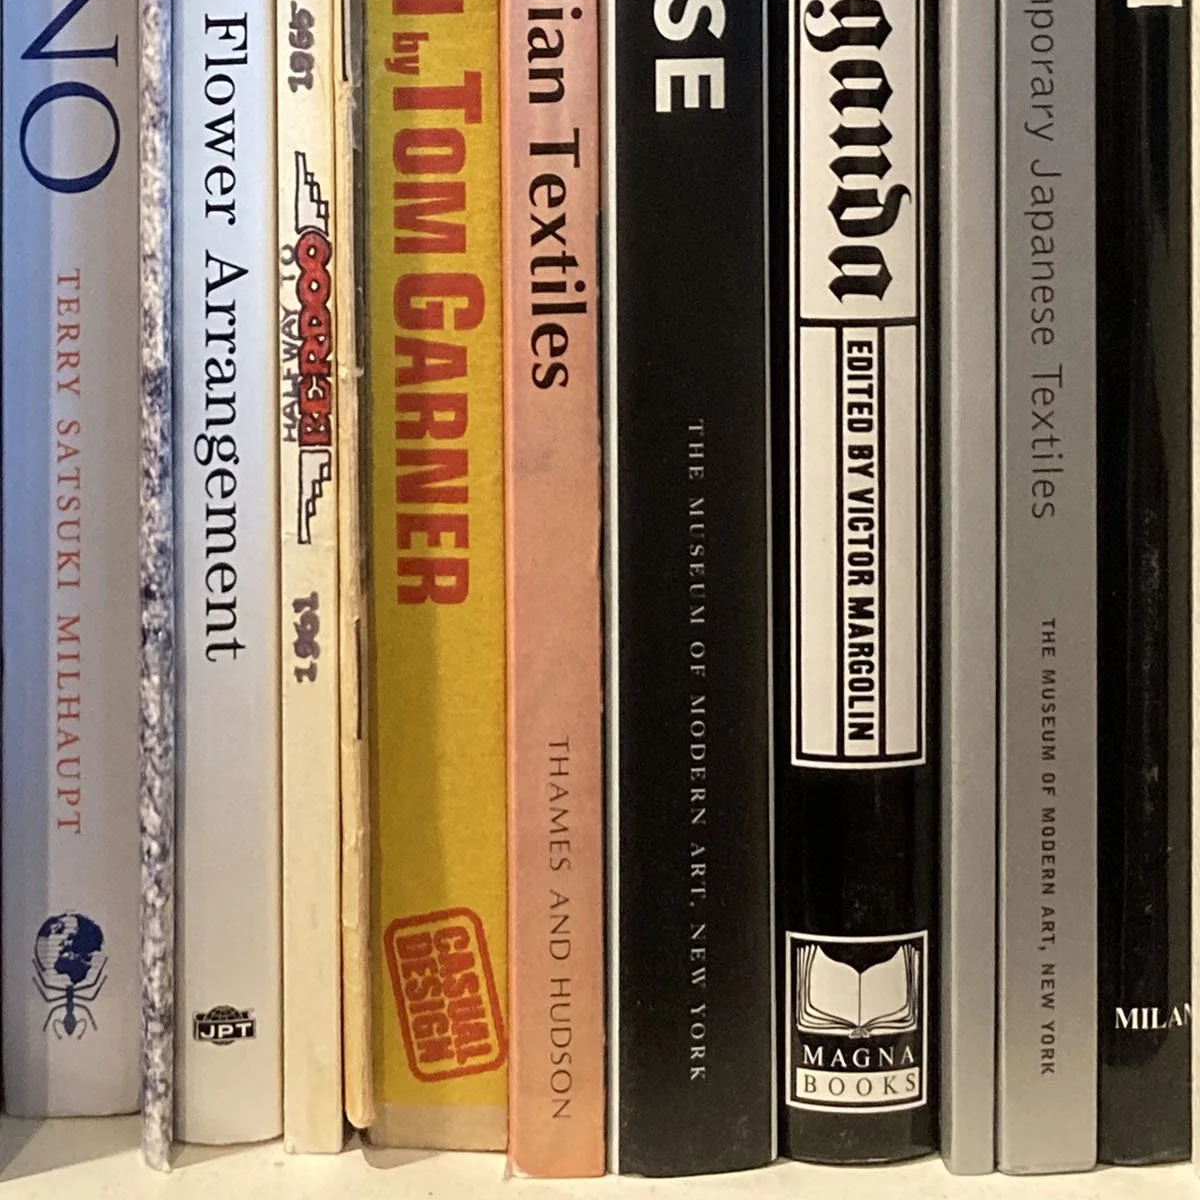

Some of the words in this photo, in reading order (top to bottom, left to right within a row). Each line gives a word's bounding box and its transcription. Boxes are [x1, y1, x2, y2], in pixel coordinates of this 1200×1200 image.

[287, 0, 315, 94] 1965
[383, 31, 430, 75] by
[204, 12, 248, 226] Flower
[391, 69, 483, 256] TOM
[280, 245, 295, 283] TO
[528, 127, 588, 390] Textiles
[1023, 158, 1062, 346] Japanese
[55, 268, 82, 398] TERRY
[281, 307, 298, 443] HALFWAY
[847, 340, 875, 433] EDITED
[194, 249, 249, 663] Arrangement
[393, 270, 487, 606] GARNER
[688, 418, 705, 480] THE
[847, 444, 875, 478] BY
[1031, 363, 1064, 519] Textiles
[55, 418, 82, 588] SATSUKI
[847, 487, 875, 587] VICTOR
[688, 497, 705, 624] MUSEUM
[291, 591, 321, 684] 1961
[689, 641, 706, 675] OF
[847, 596, 876, 741] MARGOLIN
[1041, 617, 1056, 659] THE
[53, 615, 84, 834] MILHAUPT
[690, 695, 707, 825] MODERN
[1040, 669, 1057, 761] MUSEUM
[548, 736, 571, 872] THAMES
[1041, 772, 1056, 797] OF
[1041, 807, 1056, 895] MODERN
[549, 889, 572, 961] AND
[690, 923, 706, 985] NEW
[200, 1020, 253, 1040] JPT
[398, 932, 446, 1065] DESIGN
[431, 925, 490, 1064] CASUAL
[1040, 963, 1056, 1010] NEW
[549, 977, 573, 1119] HUDSON
[690, 1003, 706, 1081] YORK
[802, 1045, 915, 1067] MAGNA
[804, 1072, 918, 1095] BOOKS
[1040, 1020, 1056, 1075] YORK
